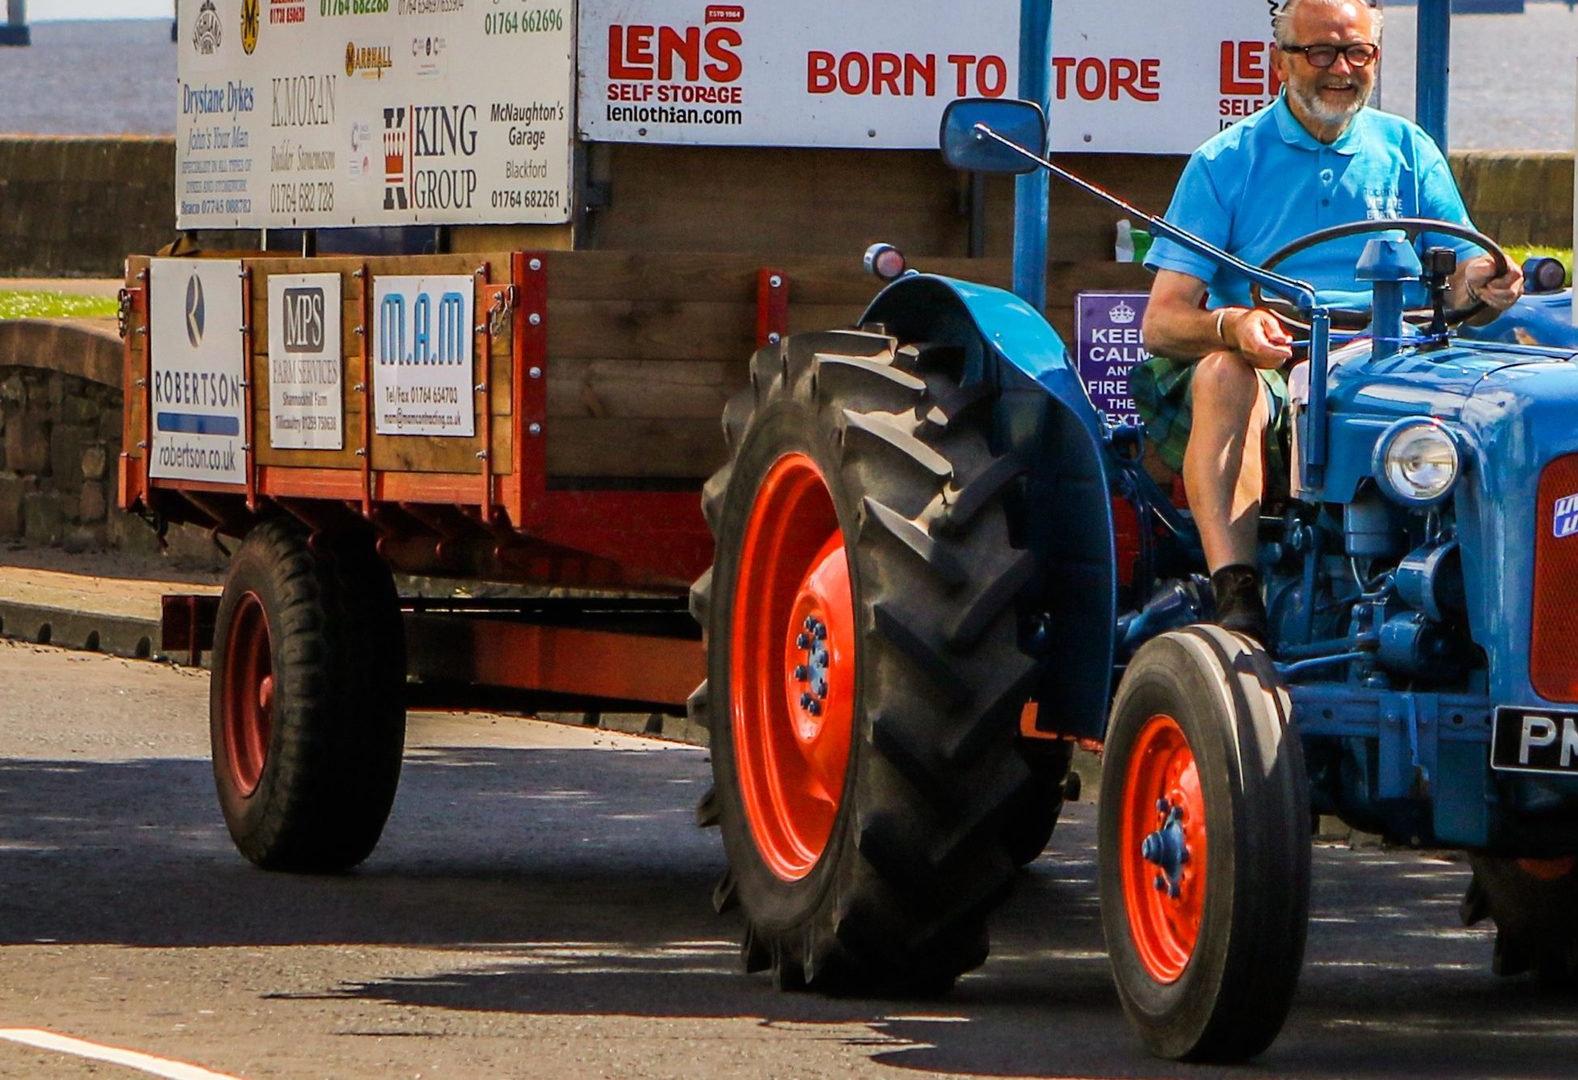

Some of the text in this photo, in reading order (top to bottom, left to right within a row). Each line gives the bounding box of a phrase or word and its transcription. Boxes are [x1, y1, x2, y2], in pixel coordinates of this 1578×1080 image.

[485, 8, 563, 35] 01764 662696
[806, 50, 936, 97] BORN
[947, 54, 1007, 98] TO
[183, 80, 254, 123] Drystane Dykes
[608, 84, 742, 104] SELF STORAGE
[490, 101, 564, 128] McNaughton's
[607, 105, 742, 125] lenlothian.com
[414, 104, 478, 157] KING
[508, 126, 546, 151] Garage
[506, 159, 548, 178] Blackford
[270, 182, 334, 213] 01764 682 728
[414, 168, 477, 210] GROUP
[491, 190, 560, 208] 01764 682261
[286, 293, 324, 347] MPS
[273, 359, 338, 384] FARM SERVICES
[155, 370, 240, 408] ROBERTSON
[386, 386, 458, 405] Tel/Fax 01764 654703
[1088, 381, 1128, 395] FIRE
[1108, 398, 1136, 409] THE
[158, 436, 237, 472] robertson.co.uk
